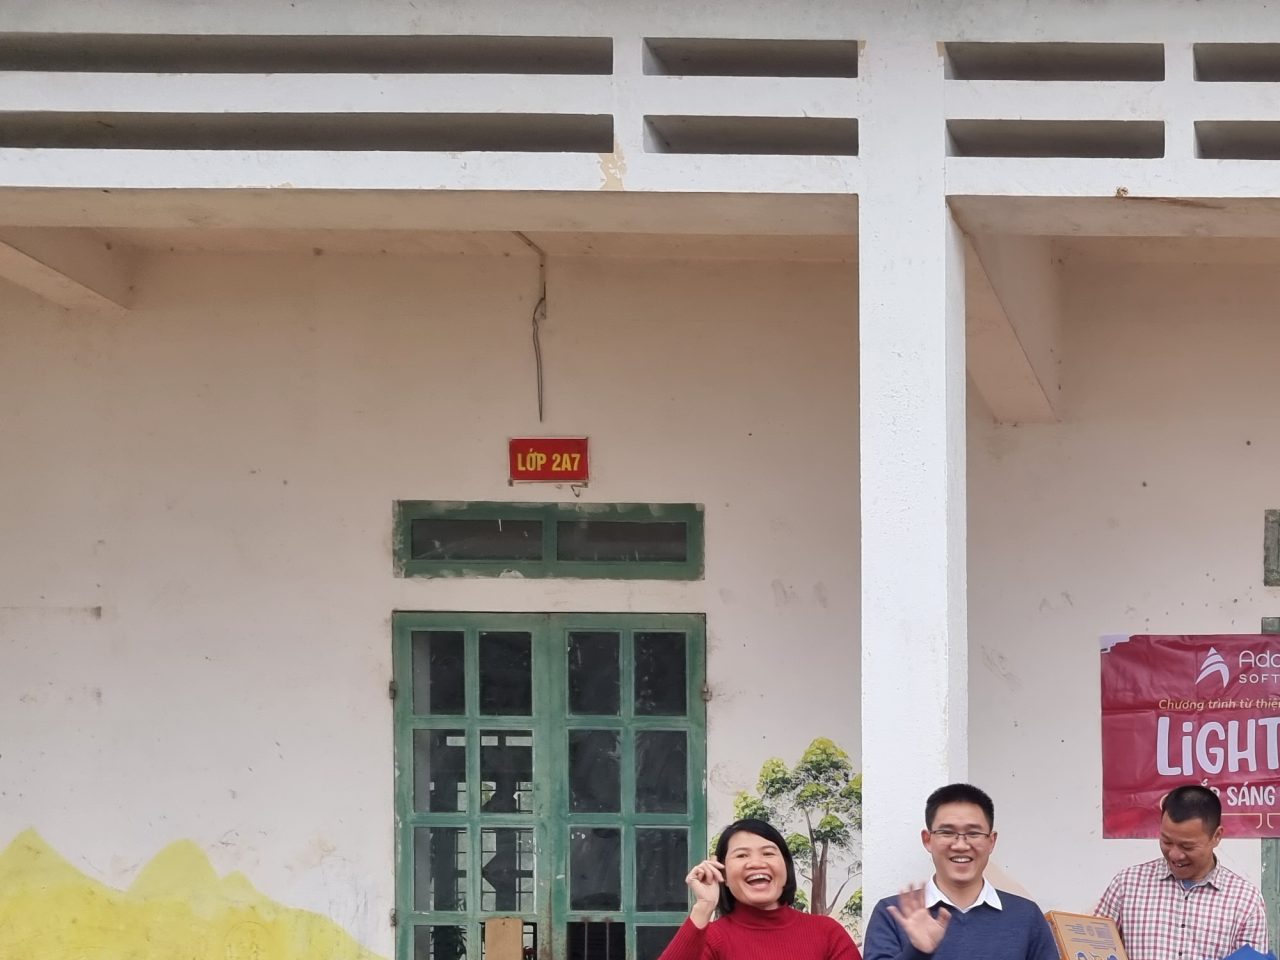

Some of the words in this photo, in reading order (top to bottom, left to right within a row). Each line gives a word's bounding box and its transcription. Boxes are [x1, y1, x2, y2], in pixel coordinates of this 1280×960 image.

[518, 448, 547, 471] LỚP
[552, 453, 581, 471] 2A7
[1208, 698, 1236, 709] trình
[1226, 781, 1276, 806] SÁNG
